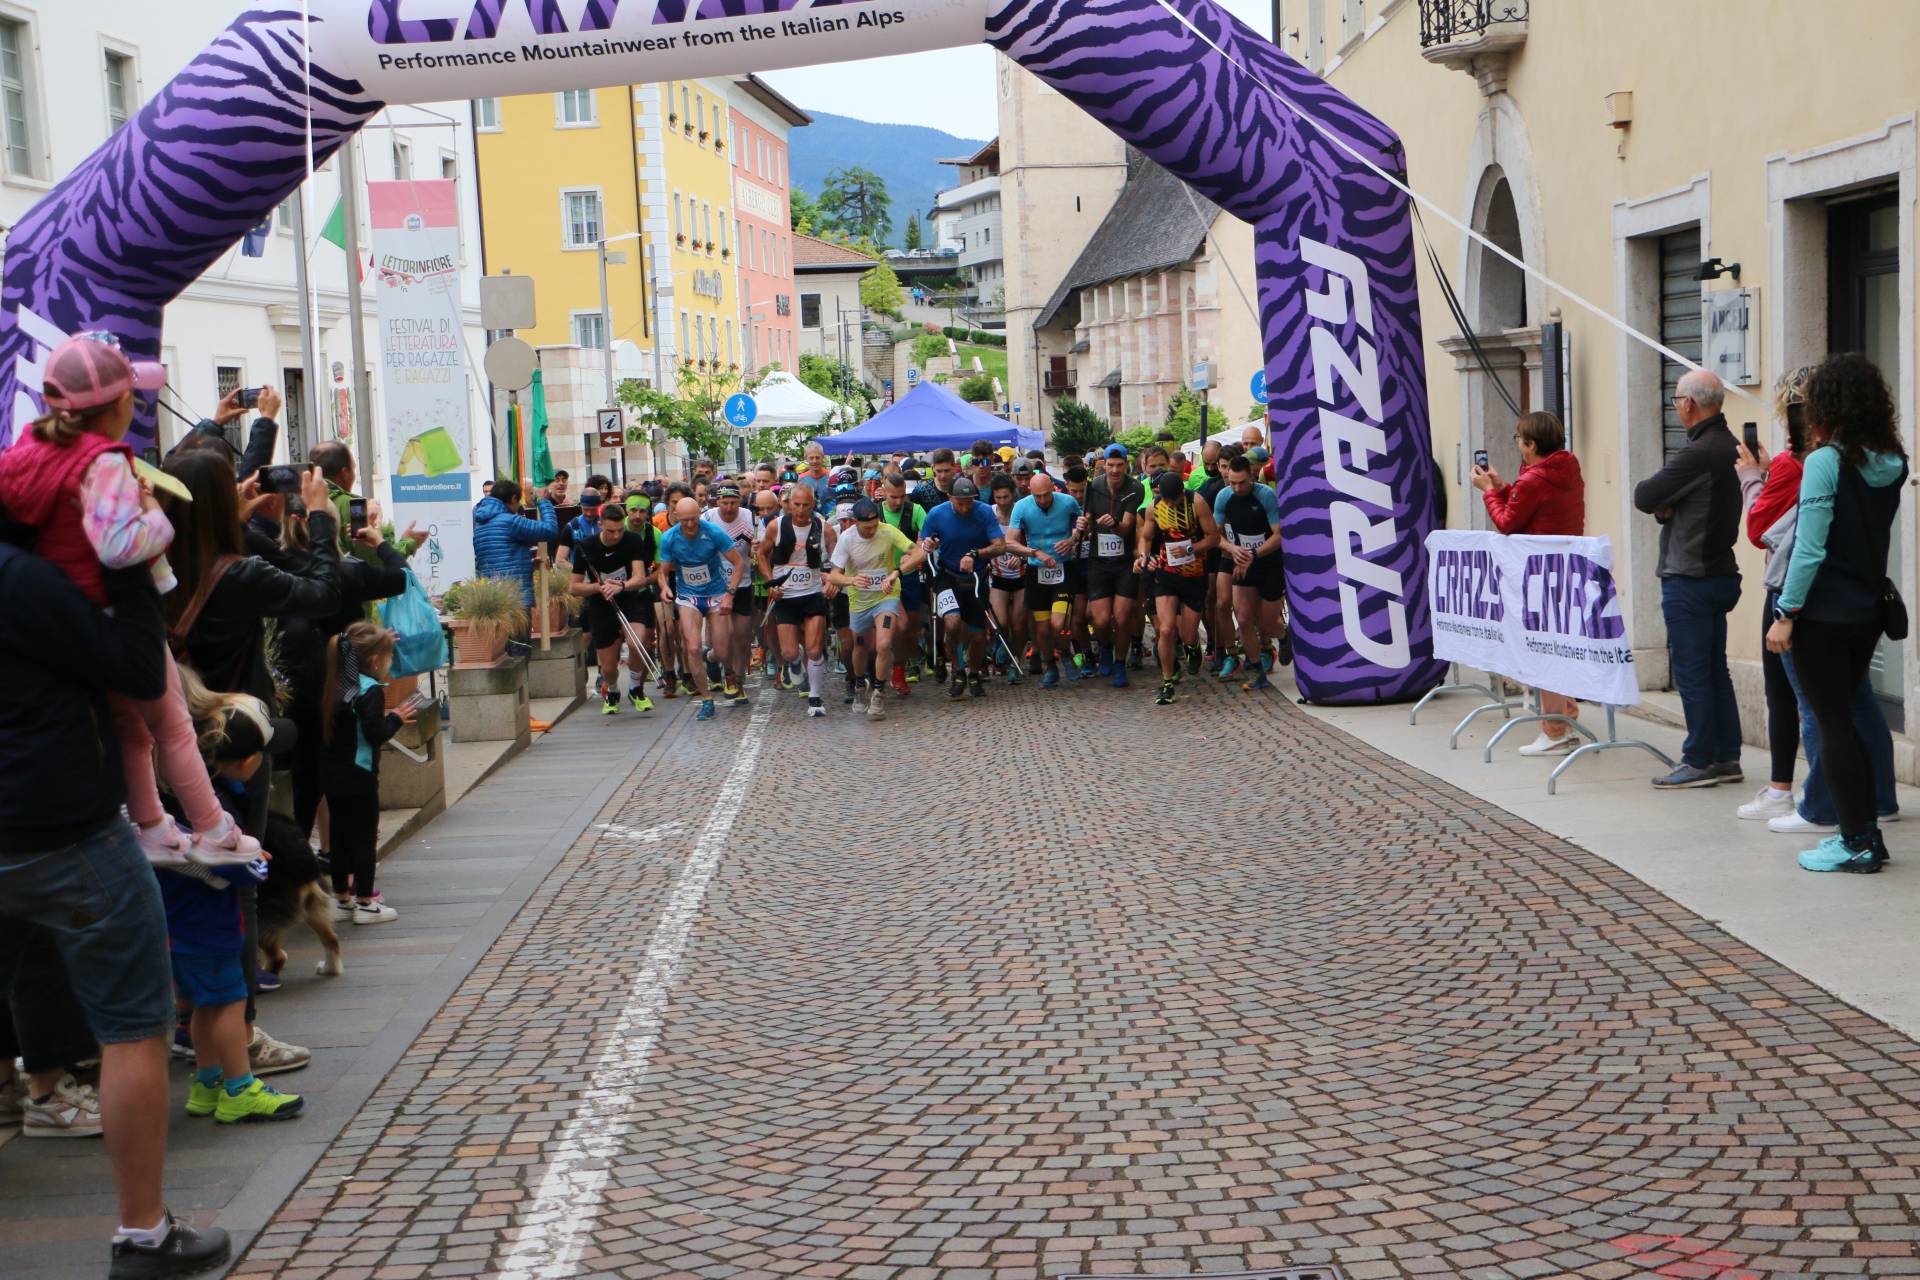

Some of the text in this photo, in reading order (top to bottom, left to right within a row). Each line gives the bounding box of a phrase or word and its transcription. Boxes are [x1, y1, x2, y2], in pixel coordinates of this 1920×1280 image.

[378, 50, 516, 70] Performance
[521, 35, 676, 62] Mountainwear
[682, 29, 735, 47] from
[739, 25, 776, 42] the
[781, 17, 850, 37] Italian
[856, 10, 906, 29] Alps
[382, 254, 454, 274] LETTORINFIORE
[389, 317, 450, 334] FESTIVAL DI
[386, 335, 458, 351] LETTERATURA
[386, 350, 460, 368] PER RAGAZZE
[405, 367, 451, 385] RAGAZZI
[1299, 235, 1410, 668] CRAZY
[1435, 550, 1504, 622] CRAZY
